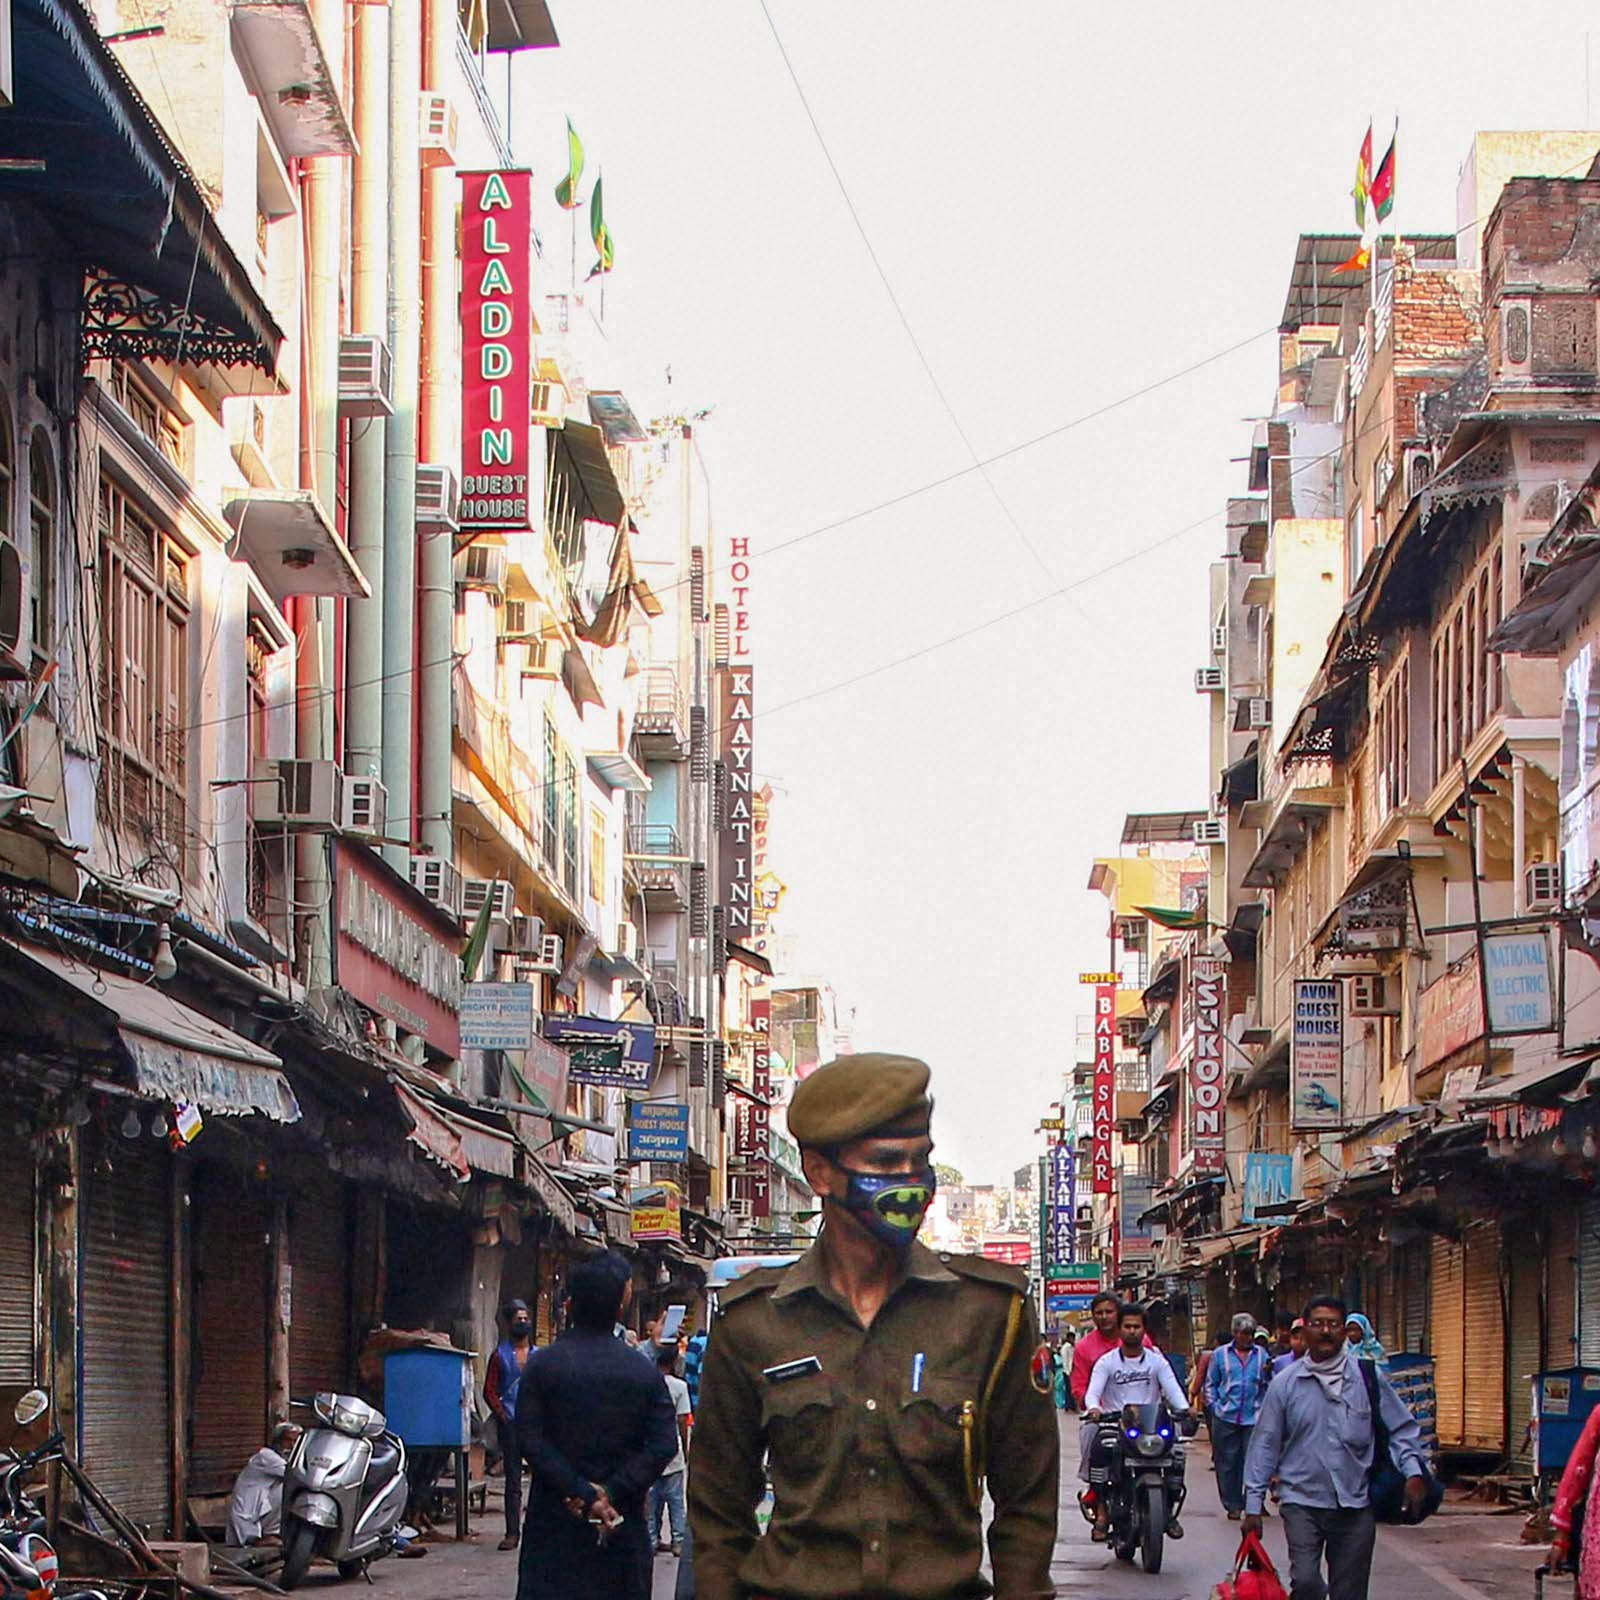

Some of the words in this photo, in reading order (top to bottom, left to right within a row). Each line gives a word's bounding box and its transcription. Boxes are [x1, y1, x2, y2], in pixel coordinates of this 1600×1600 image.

[480, 173, 512, 467] ALADDIN
[462, 475, 527, 496] GUEST
[461, 498, 527, 519] HOUSE
[730, 537, 750, 656] HOTEL
[729, 672, 752, 846] KAAYNAT
[728, 857, 750, 928] INN
[1489, 943, 1545, 968] NATIONAL
[1195, 959, 1227, 975] HOTEL
[1080, 973, 1121, 984] HOTEL
[1494, 975, 1545, 996] ELECTRIC
[1300, 985, 1336, 999] AVON
[1297, 1002, 1339, 1017] GUEST
[1505, 1003, 1538, 1024] STORE
[1097, 997, 1112, 1075] BABA
[1296, 1020, 1340, 1035] HOUSE
[1195, 983, 1221, 1134] SUKOON
[1042, 1119, 1064, 1129] NEW
[1095, 1084, 1111, 1182] SAGAR
[1057, 1146, 1071, 1207] ALLAH
